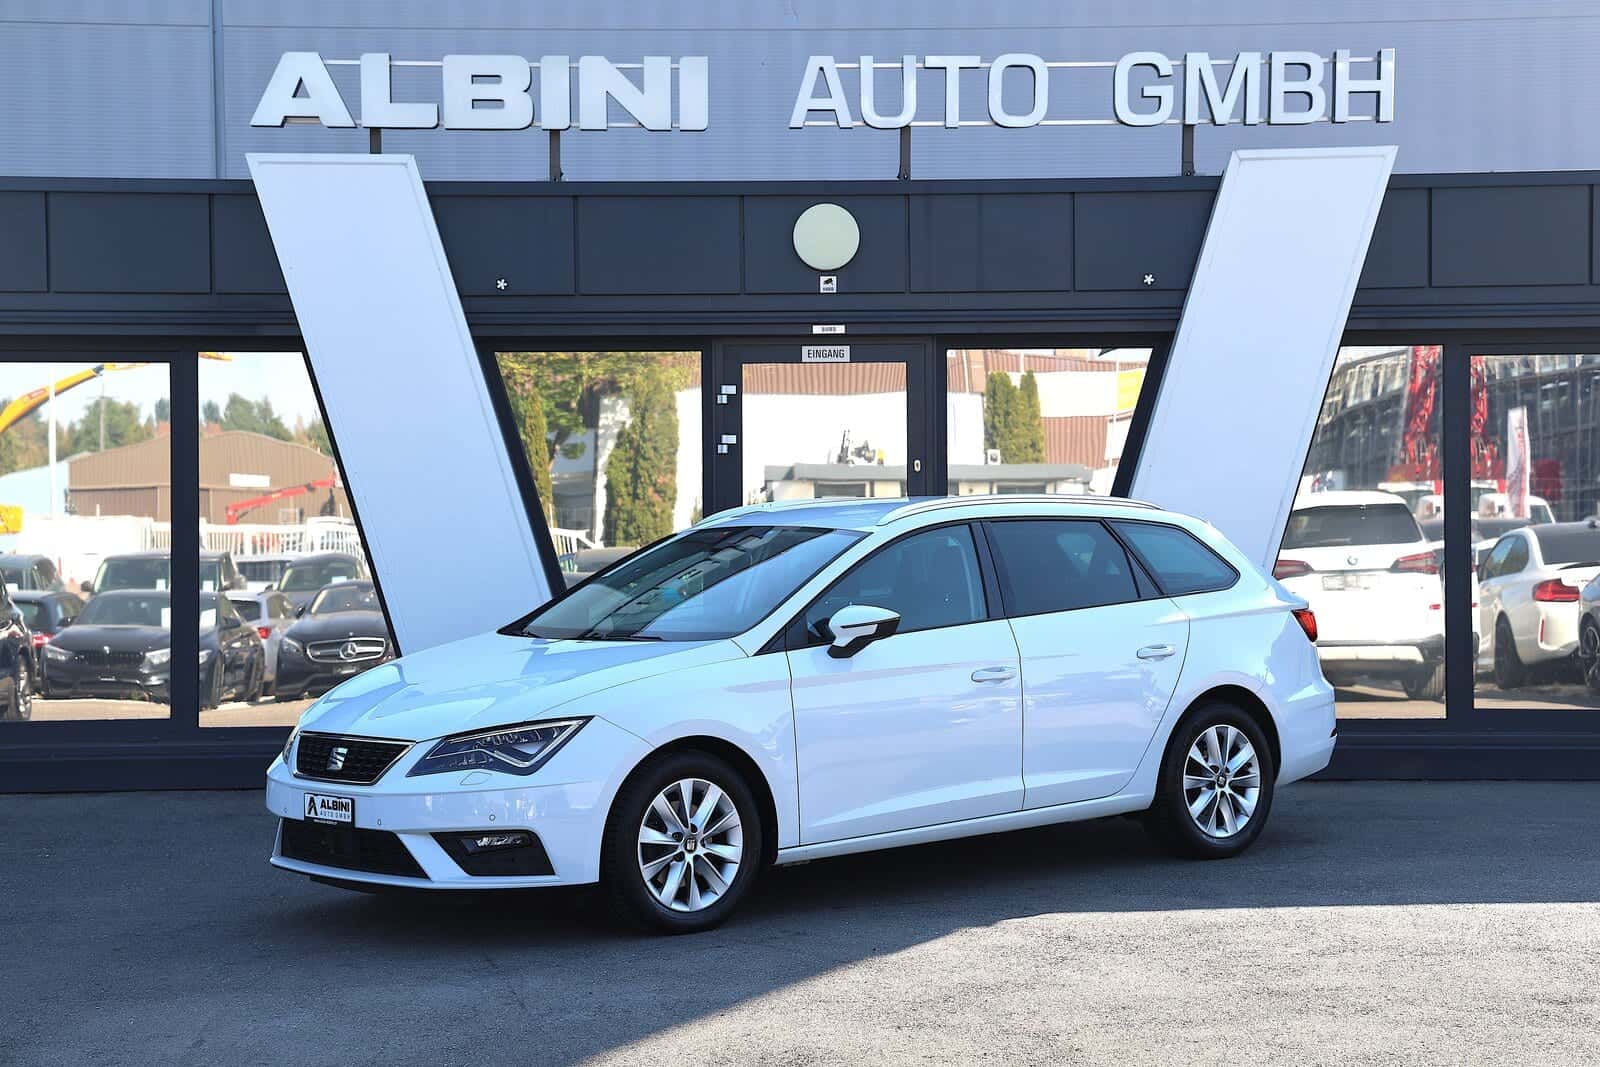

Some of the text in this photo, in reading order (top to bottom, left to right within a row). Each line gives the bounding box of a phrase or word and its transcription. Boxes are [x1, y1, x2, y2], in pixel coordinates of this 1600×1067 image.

[250, 48, 1396, 132] ALBINI AUTO GMBH
[807, 349, 845, 358] EINGANG
[320, 798, 350, 812] ALBINI
